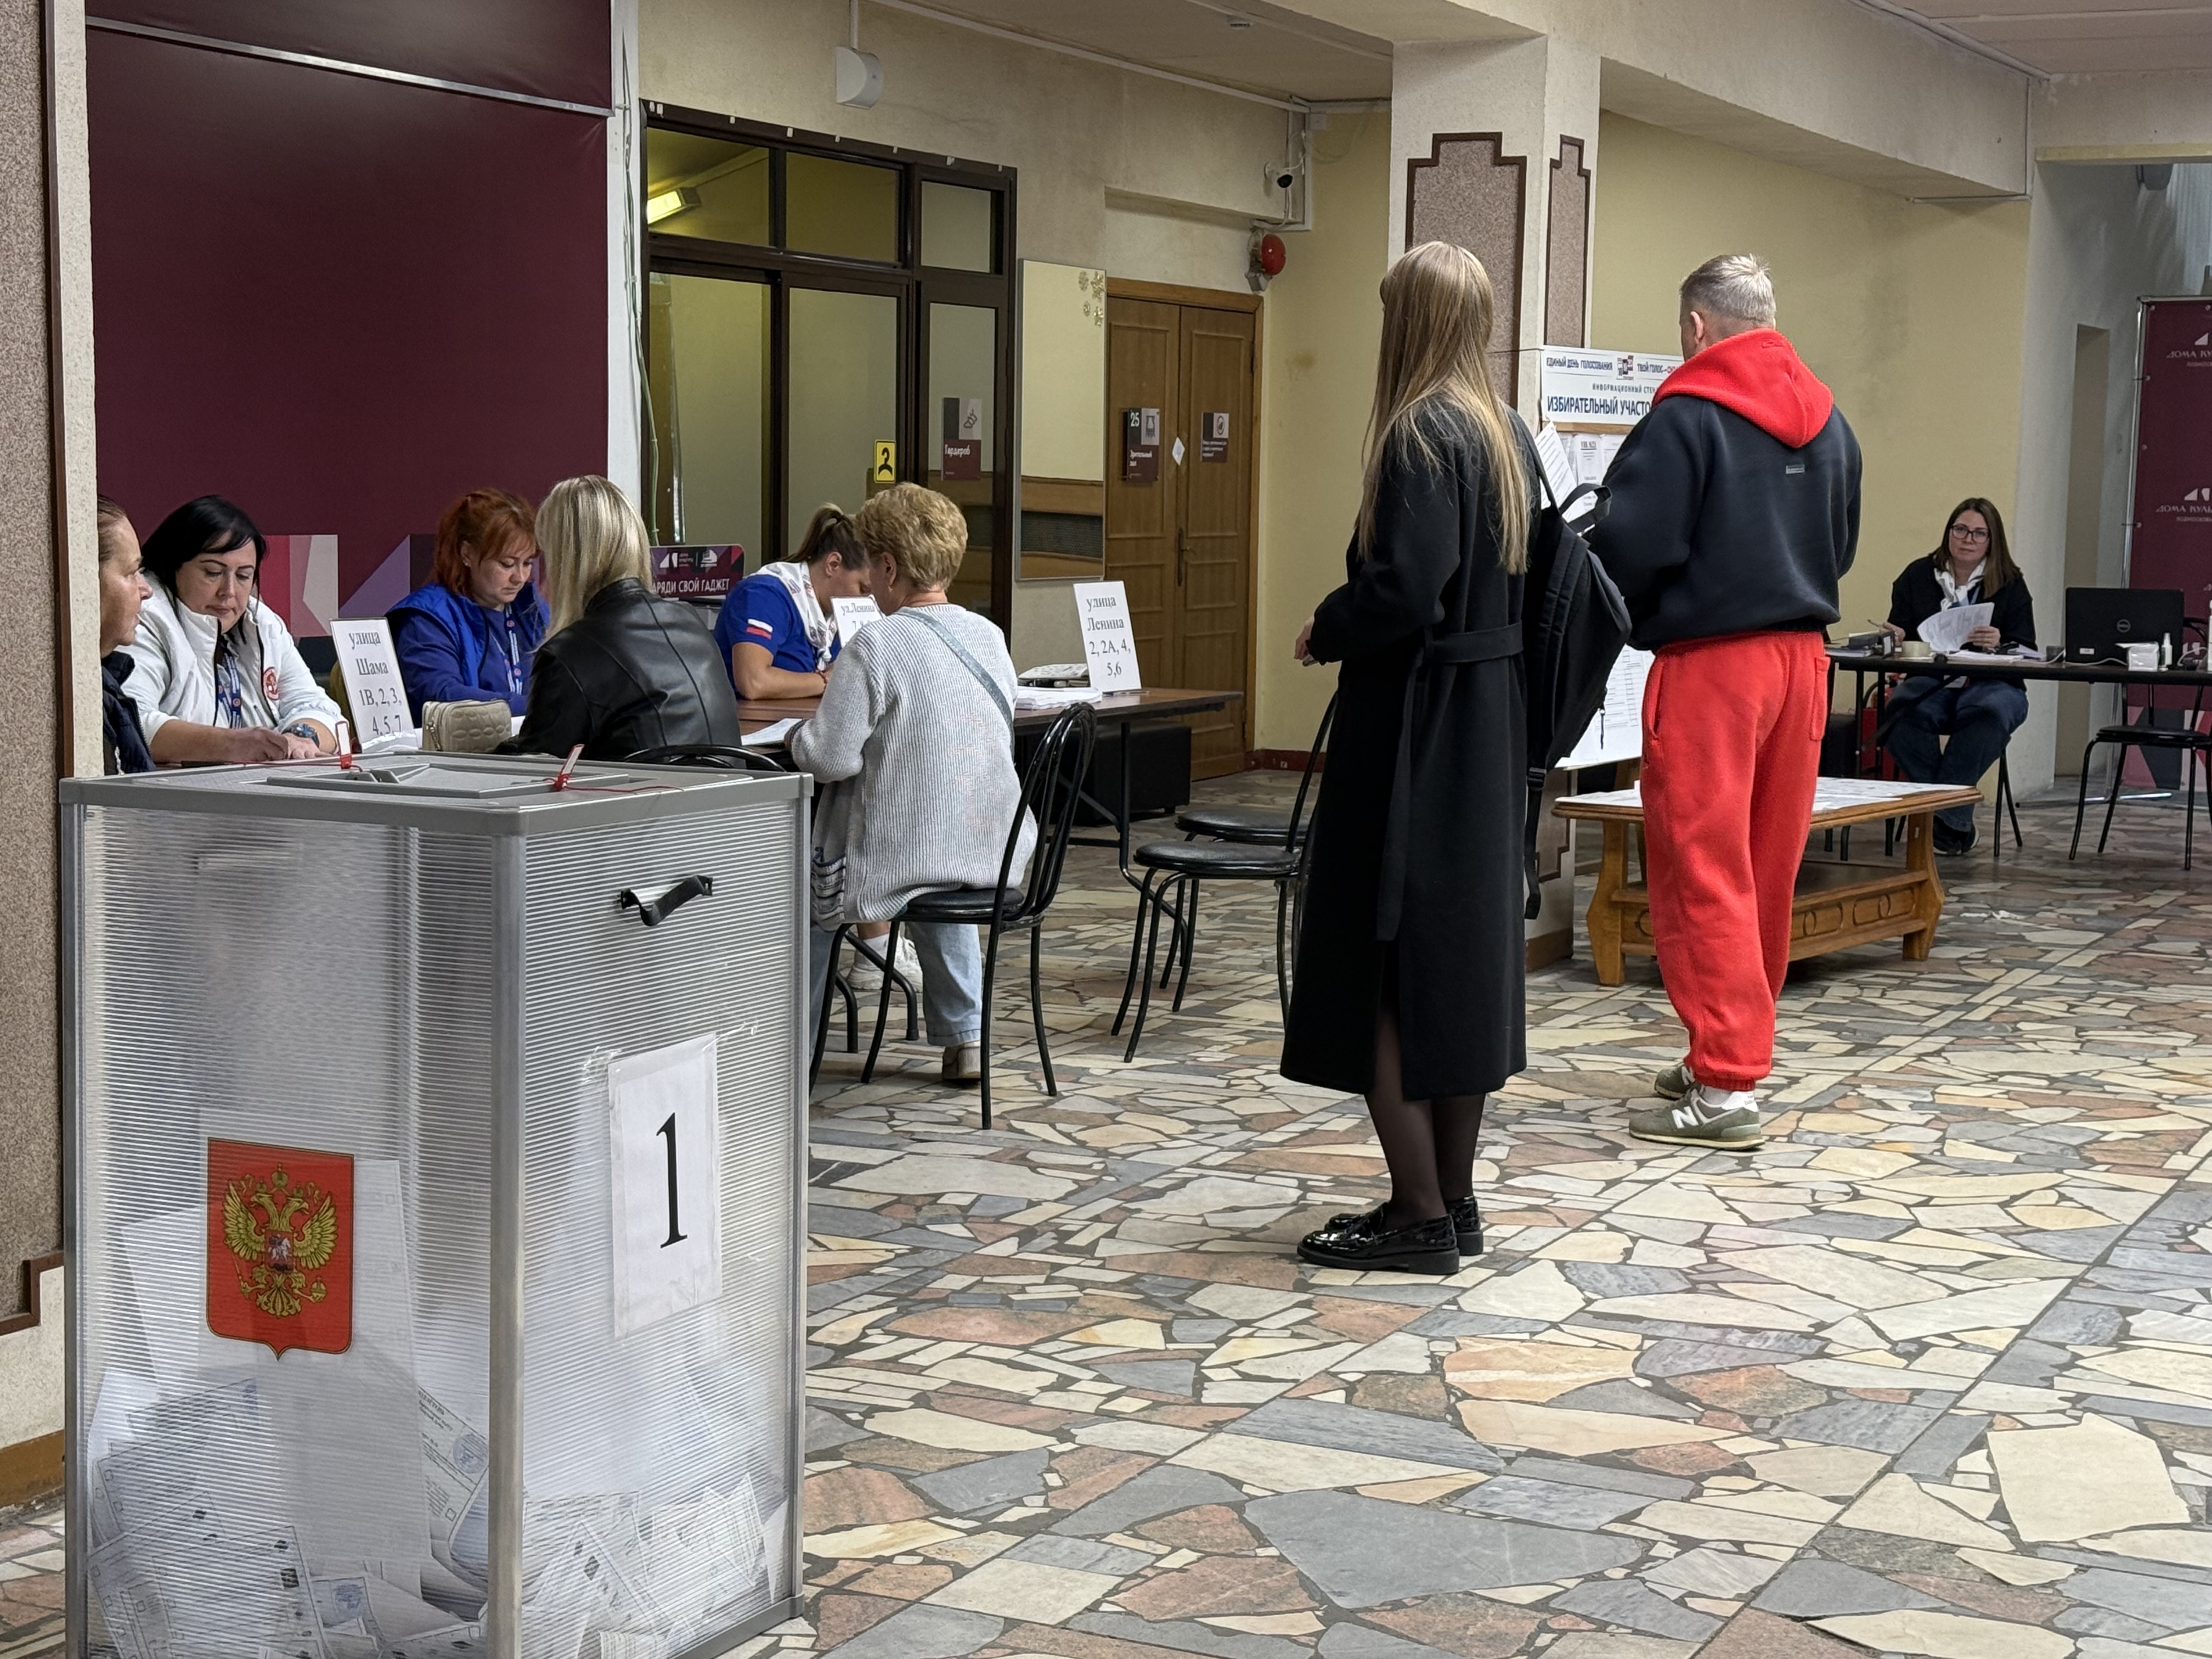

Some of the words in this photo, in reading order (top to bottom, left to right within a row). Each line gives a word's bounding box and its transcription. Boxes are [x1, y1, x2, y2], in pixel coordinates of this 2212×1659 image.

[2166, 350, 2197, 358] ДОМА
[1592, 383, 1642, 393] ИНФОРМАЦИОННЫЙ
[1644, 386, 1655, 394] СТЕН
[1547, 396, 1618, 415] ИЗБИРАТЕЛЬНЫЙ
[1620, 399, 1651, 416] УЧАСТО
[1130, 412, 1140, 427] 25
[2155, 504, 2186, 513] ДОМА
[651, 580, 676, 594] АРЯДИ
[678, 577, 699, 592] СВОЙ
[701, 578, 730, 592] ГАДЖЕТ
[1086, 596, 1117, 612] улица
[1087, 617, 1125, 631] Ленина
[349, 631, 381, 650] улица
[356, 658, 389, 675] Шама
[1672, 1105, 1699, 1128] N
[656, 1111, 688, 1249] 1
